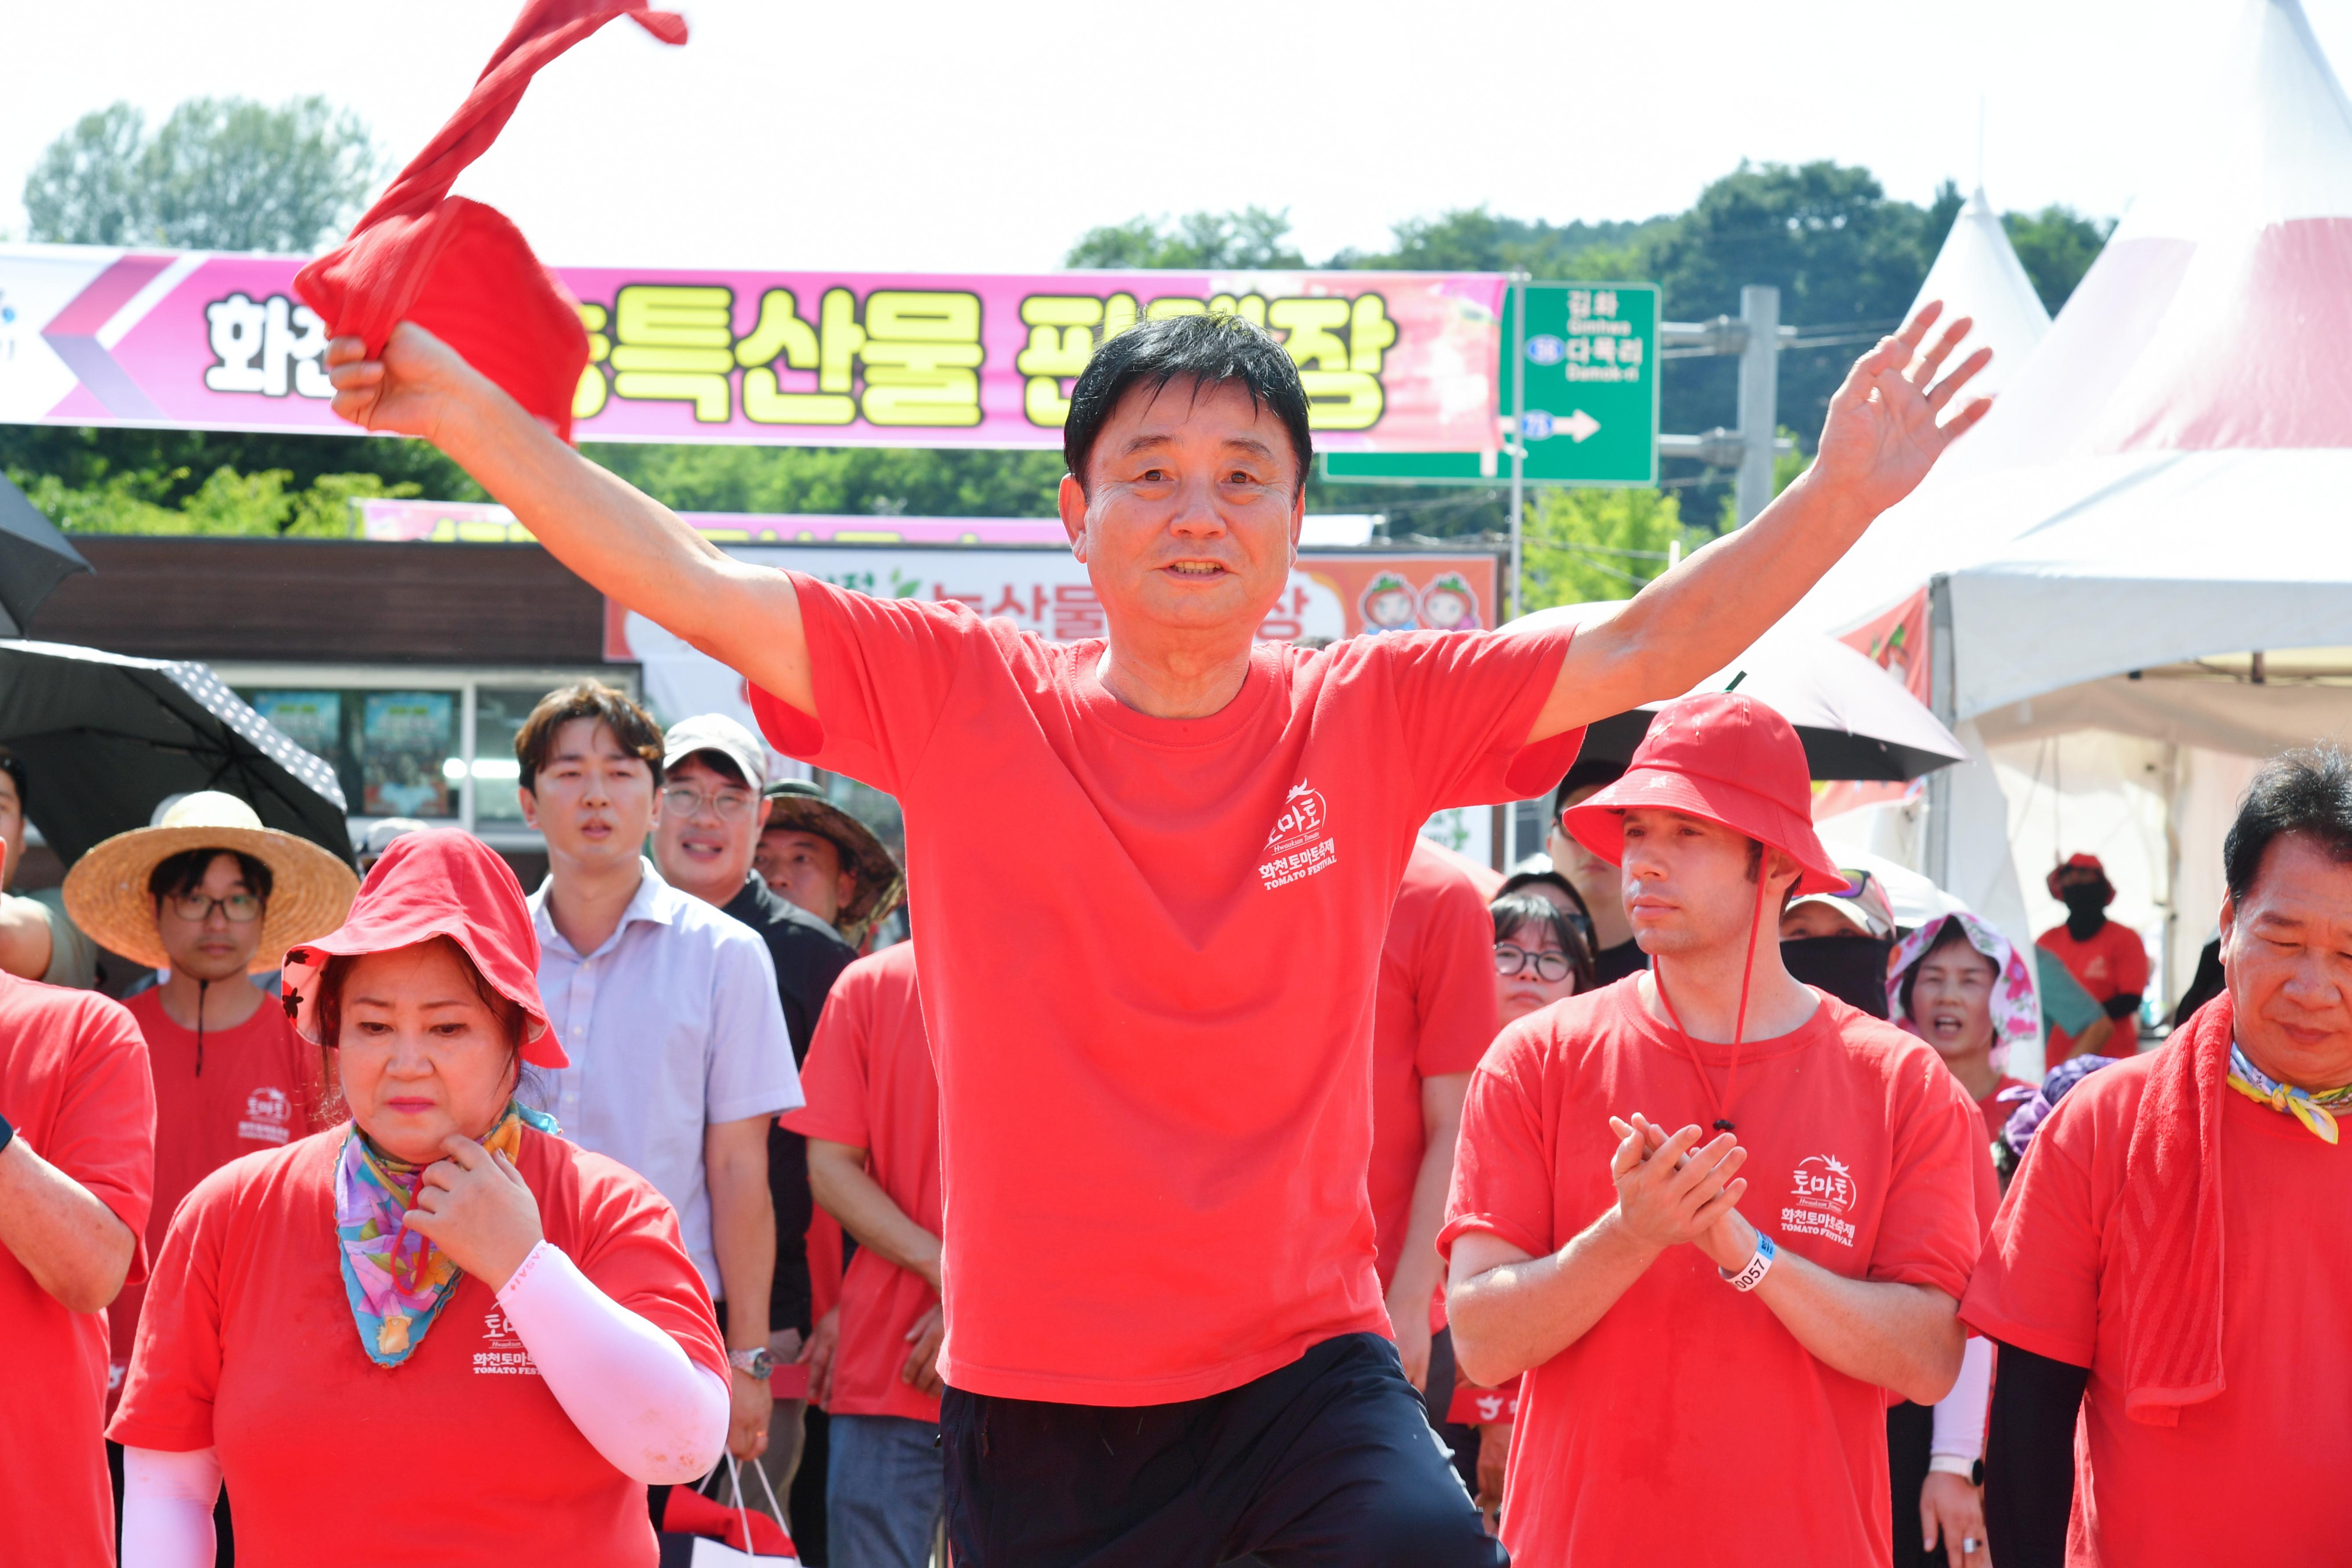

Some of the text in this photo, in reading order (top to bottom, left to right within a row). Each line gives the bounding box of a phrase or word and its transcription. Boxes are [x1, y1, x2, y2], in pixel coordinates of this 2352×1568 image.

[572, 283, 984, 427] 특산물
[1016, 290, 1399, 432] 판장
[1565, 335, 1644, 366] 다목리
[1258, 837, 1335, 879] 화천토마토축제
[1264, 855, 1337, 891] TOMATO FESTIVAL
[1790, 1170, 1848, 1205] 토마토
[1781, 1207, 1855, 1239] 화천토마토축제
[1781, 1223, 1819, 1235] TOMATO
[1735, 1257, 1765, 1289] 0057
